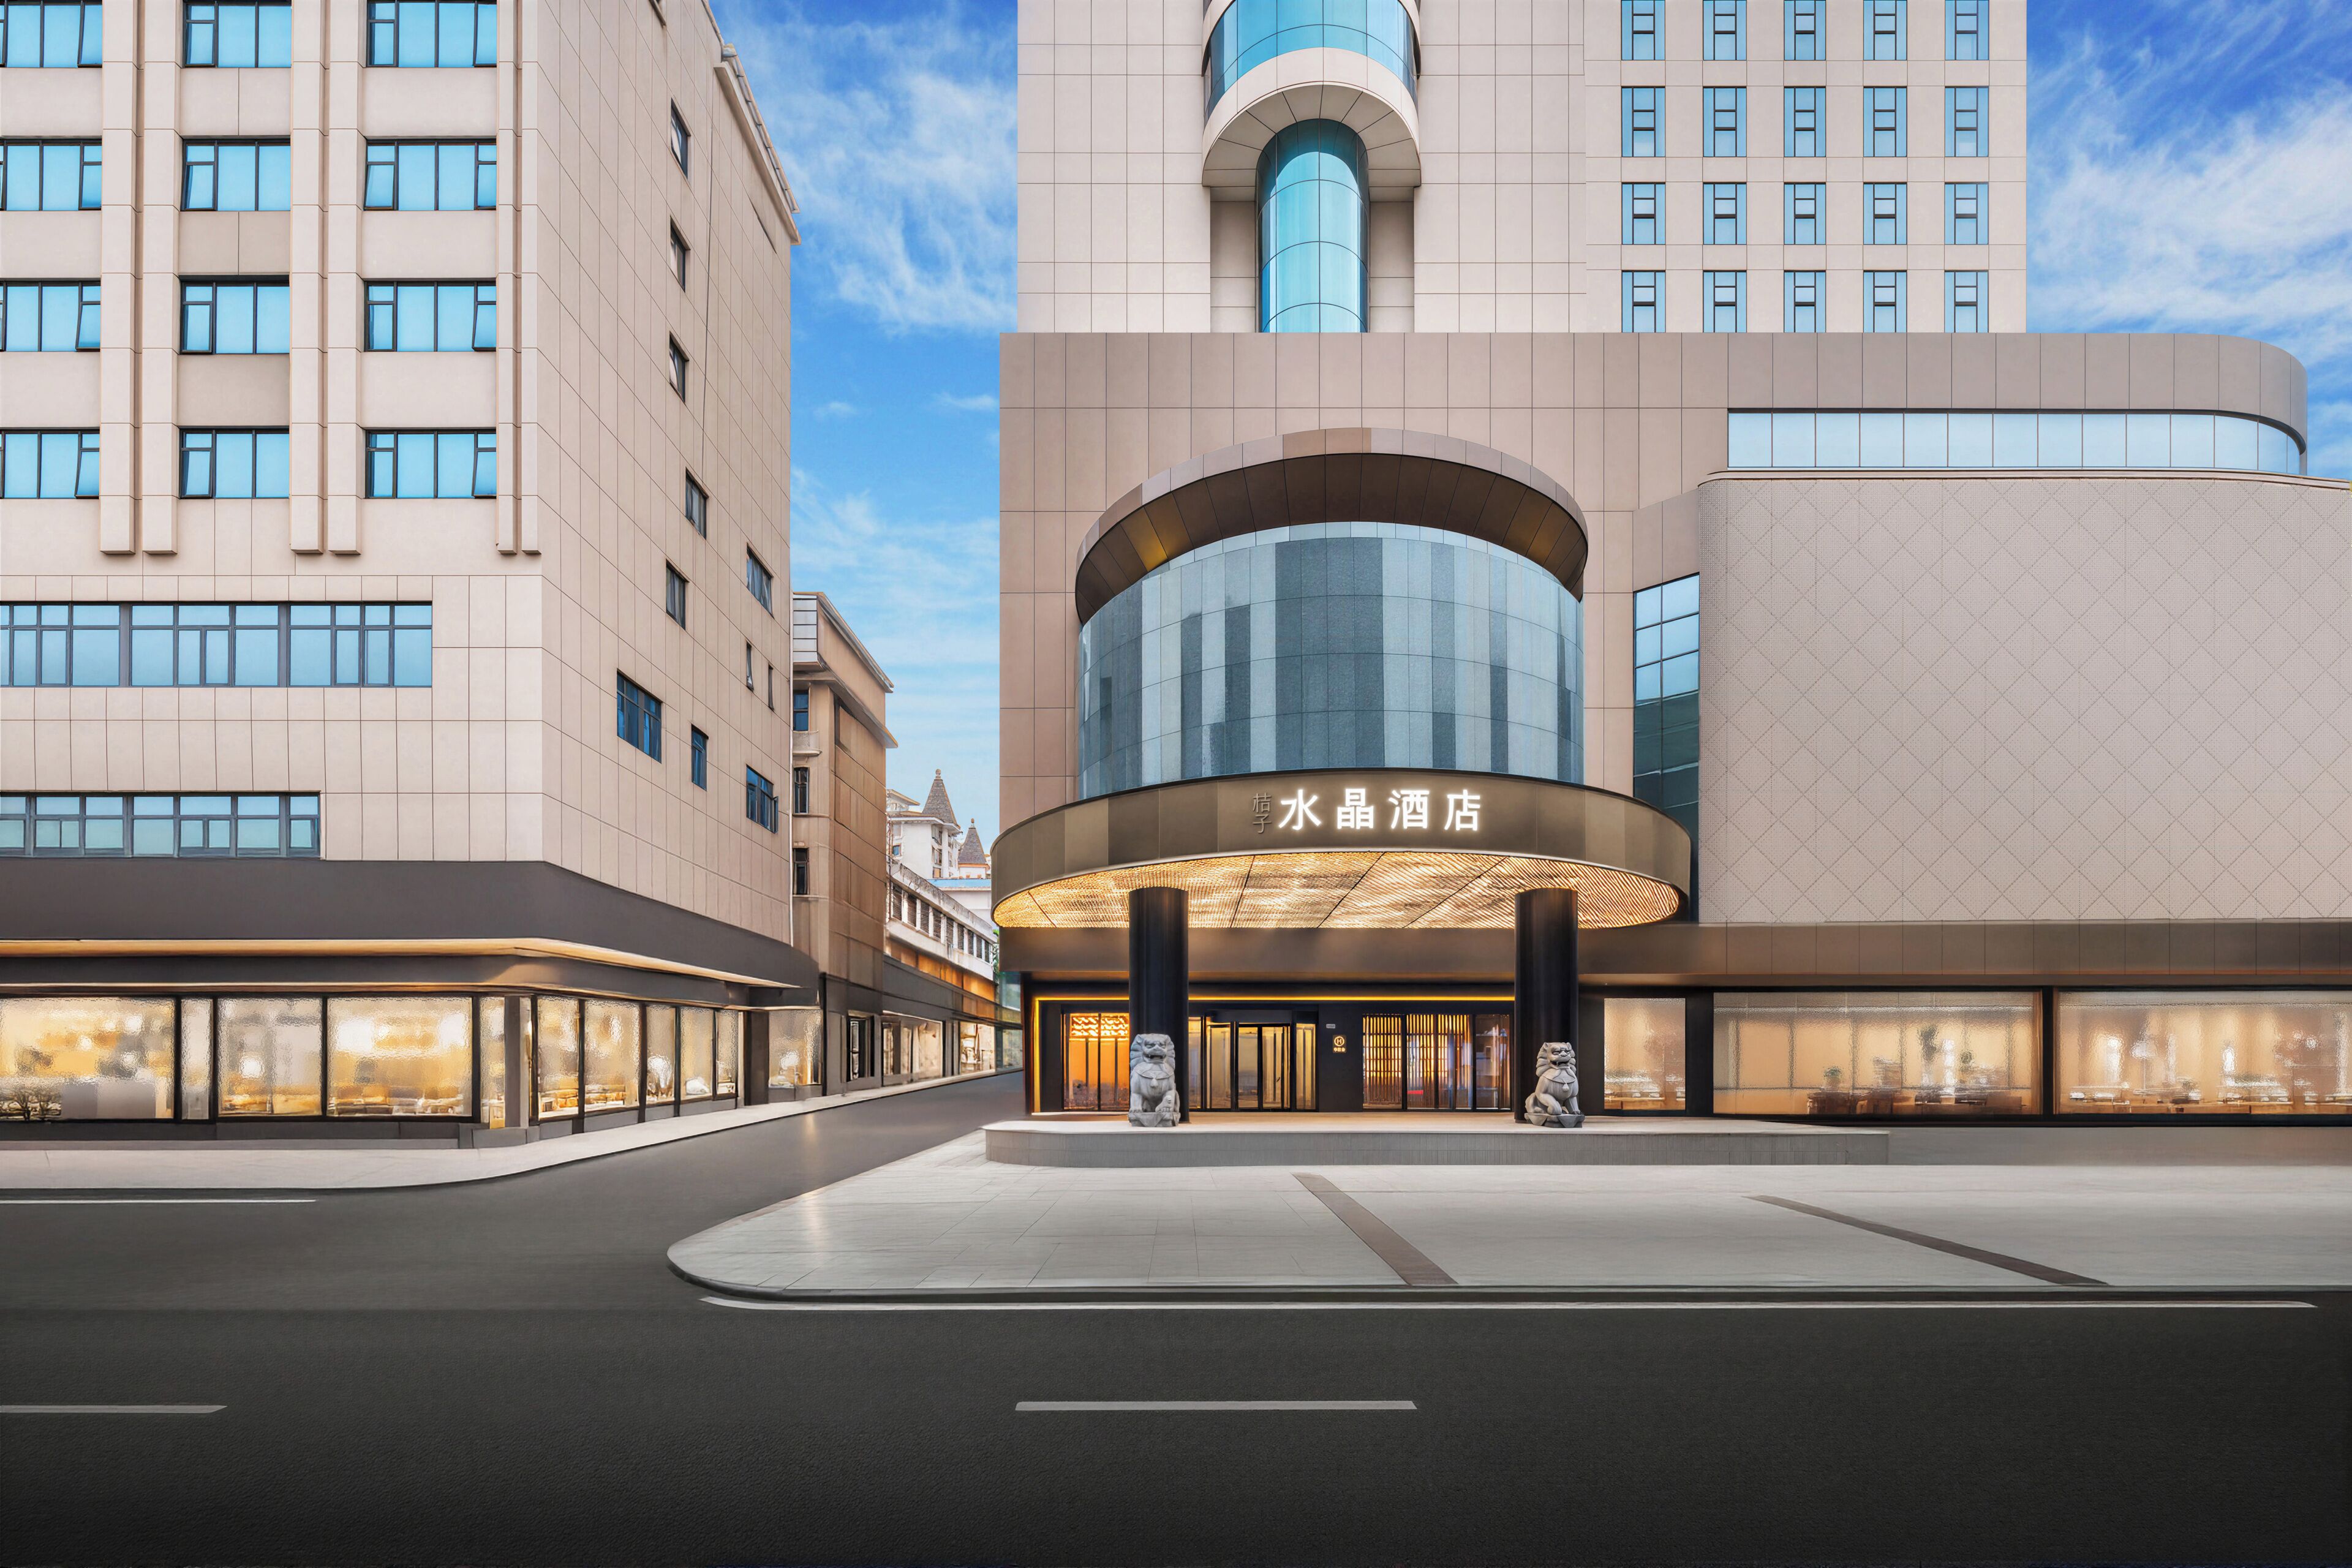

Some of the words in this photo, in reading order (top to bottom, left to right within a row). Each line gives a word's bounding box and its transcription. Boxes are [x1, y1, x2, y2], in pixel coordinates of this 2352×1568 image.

[1253, 793, 1272, 834] 桔子
[1278, 788, 1480, 831] 水晶酒店
